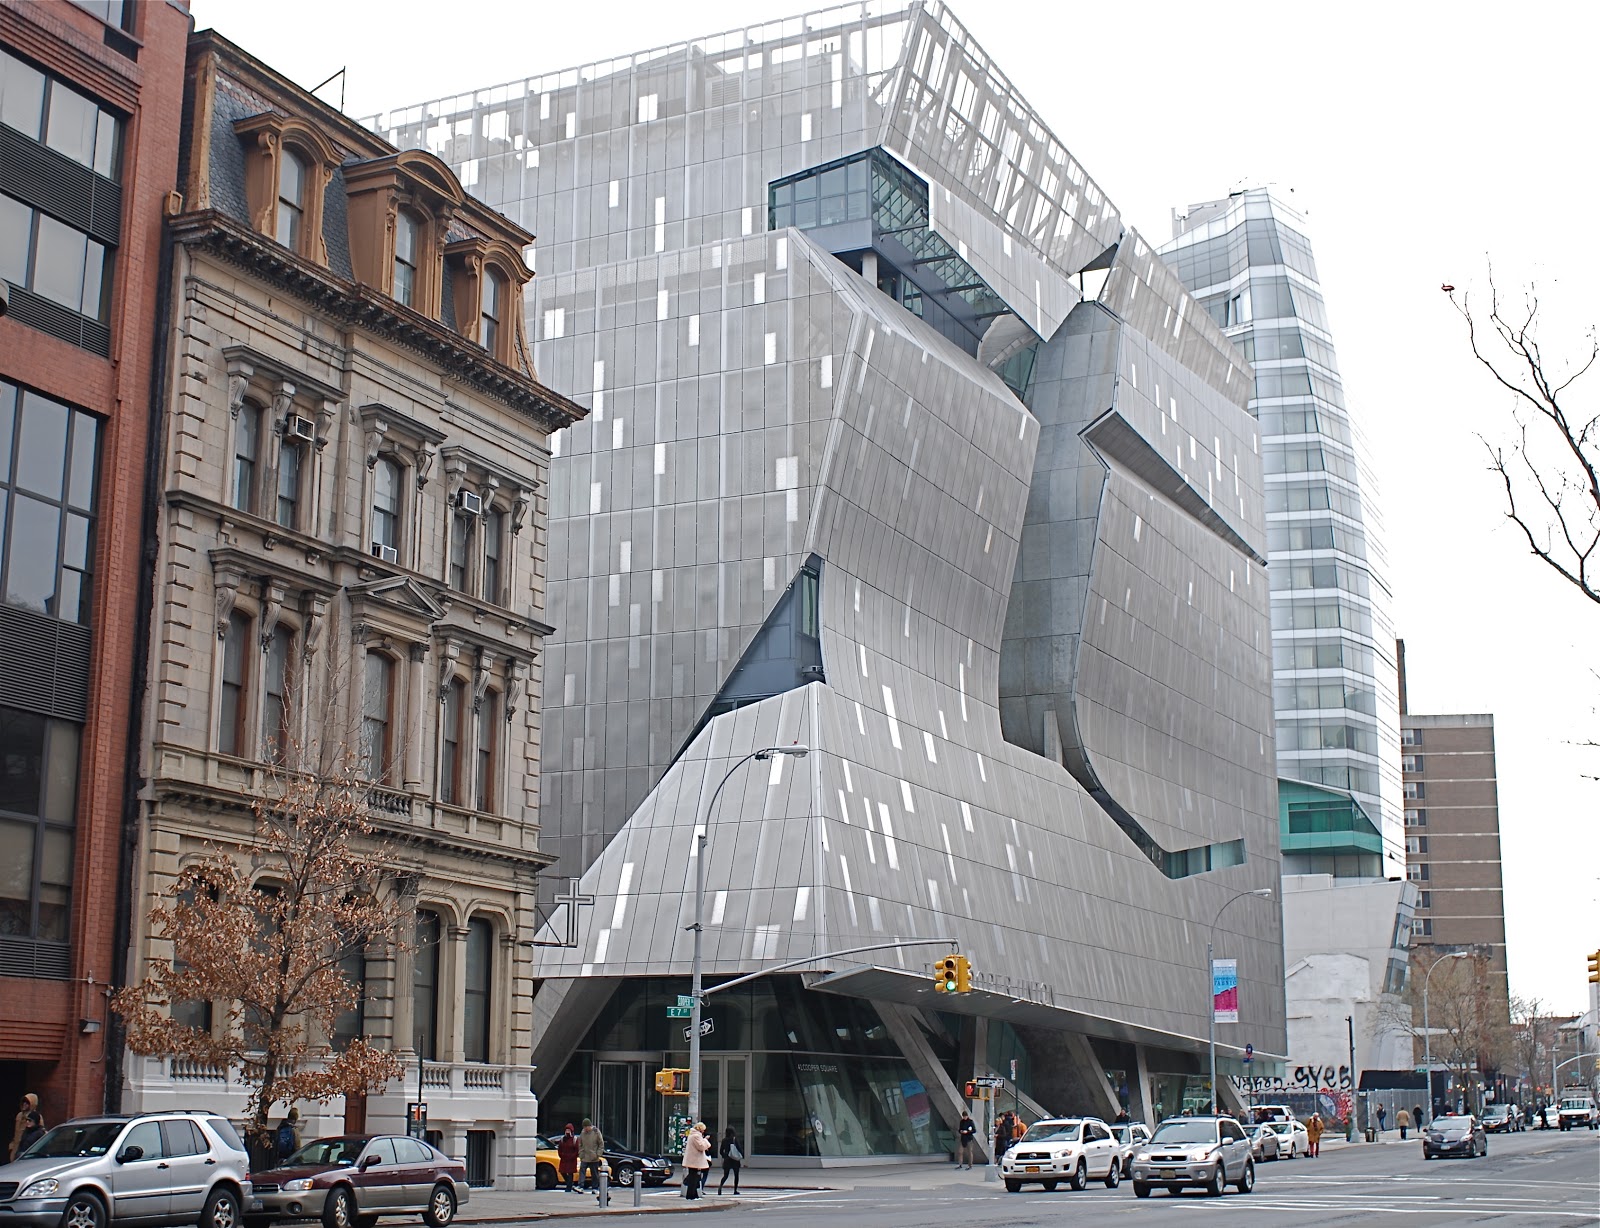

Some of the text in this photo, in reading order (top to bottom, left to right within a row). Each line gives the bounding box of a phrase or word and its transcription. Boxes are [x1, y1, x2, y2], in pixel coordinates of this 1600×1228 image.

[677, 997, 690, 1006] COOPER
[671, 1008, 675, 1016] E
[677, 1008, 681, 1016] 7
